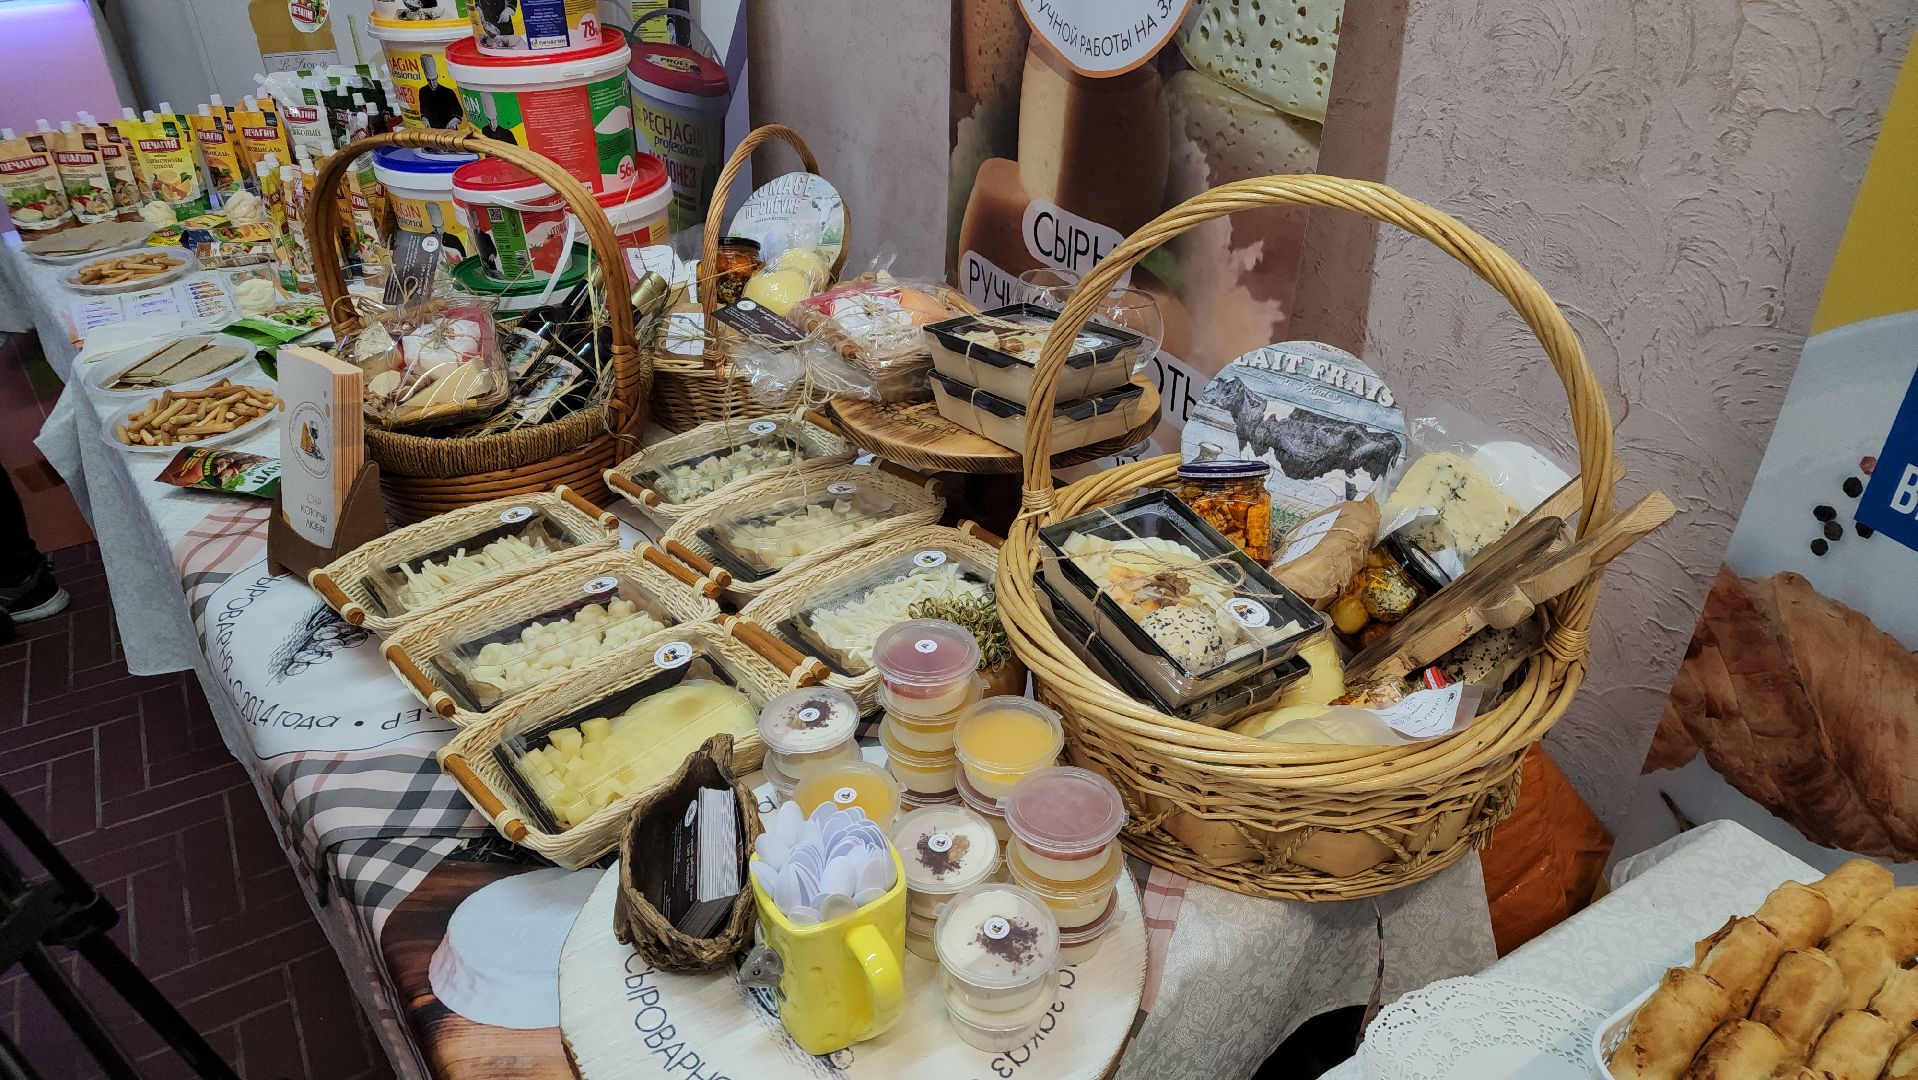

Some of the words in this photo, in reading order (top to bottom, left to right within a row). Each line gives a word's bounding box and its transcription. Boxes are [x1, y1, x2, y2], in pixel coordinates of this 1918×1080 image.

[1030, 0, 1078, 48] УЧНОЙ
[1079, 29, 1132, 57] РАБОТЫ
[1134, 13, 1158, 43] НА
[140, 140, 178, 150] ПЕЧАГИН
[642, 107, 697, 146] PECHAGI
[215, 576, 282, 680] ЫРОВАРНЯ
[241, 691, 280, 727] 2014
[624, 952, 731, 1080] СЫРОВАРН
